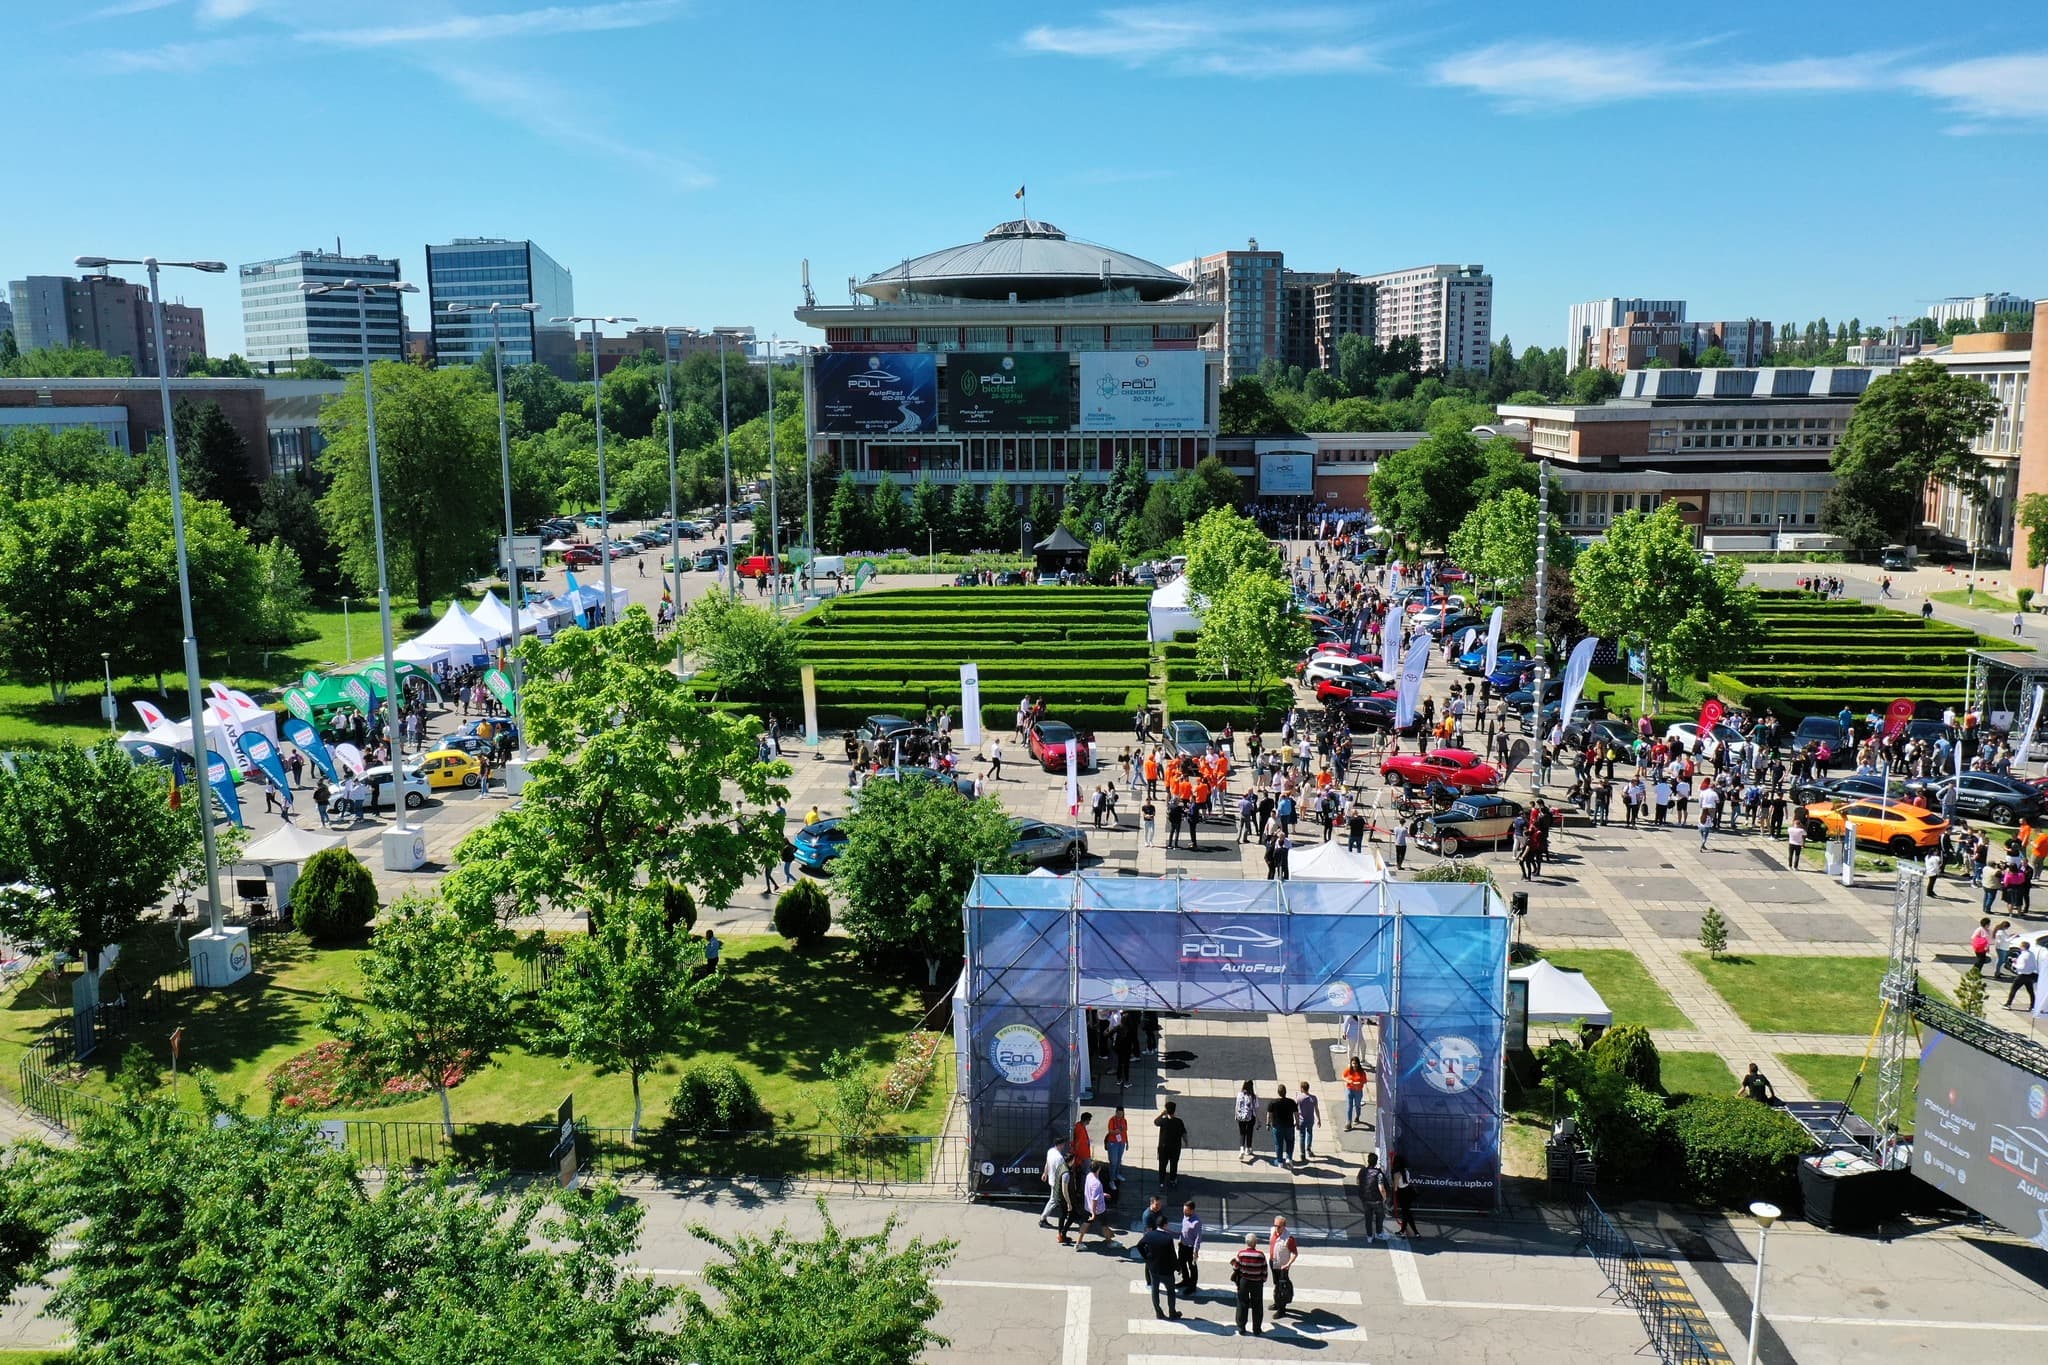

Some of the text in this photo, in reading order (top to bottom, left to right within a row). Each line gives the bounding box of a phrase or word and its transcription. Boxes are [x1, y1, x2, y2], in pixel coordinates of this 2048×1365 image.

[848, 380, 881, 388] POLI
[980, 375, 1016, 384] POLI
[982, 385, 1015, 393] biofest
[1121, 381, 1156, 389] POLI
[1182, 943, 1243, 957] POLI
[1221, 963, 1287, 973] AutoFest
[1000, 1050, 1035, 1063] 200
[1990, 1135, 2038, 1175] POLI
